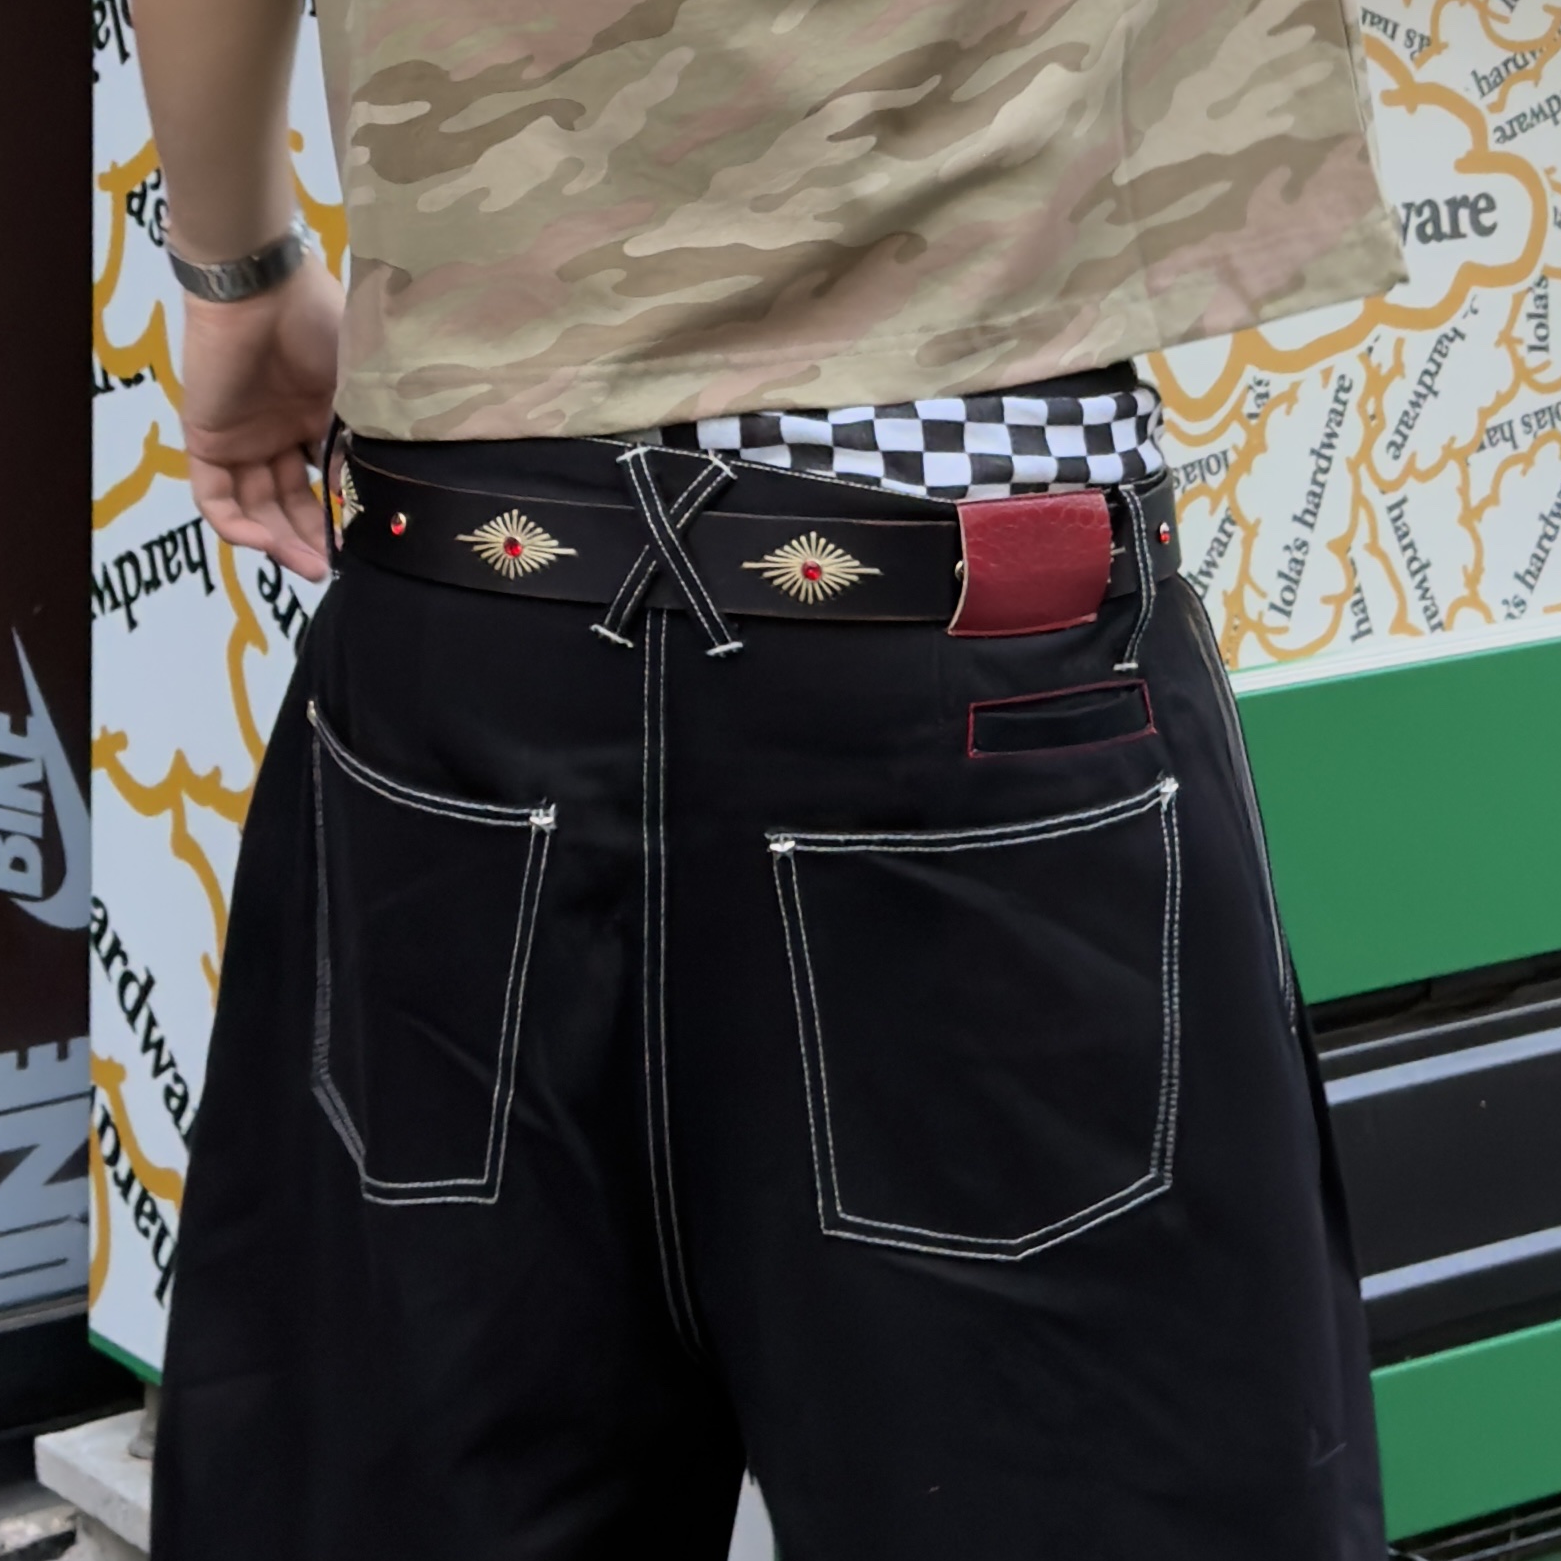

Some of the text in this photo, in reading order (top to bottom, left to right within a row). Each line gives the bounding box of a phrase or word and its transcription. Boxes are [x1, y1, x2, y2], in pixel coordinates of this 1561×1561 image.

[1385, 325, 1467, 462] hardware
[1267, 372, 1354, 623] lola's hardware
[90, 516, 215, 634] hardw
